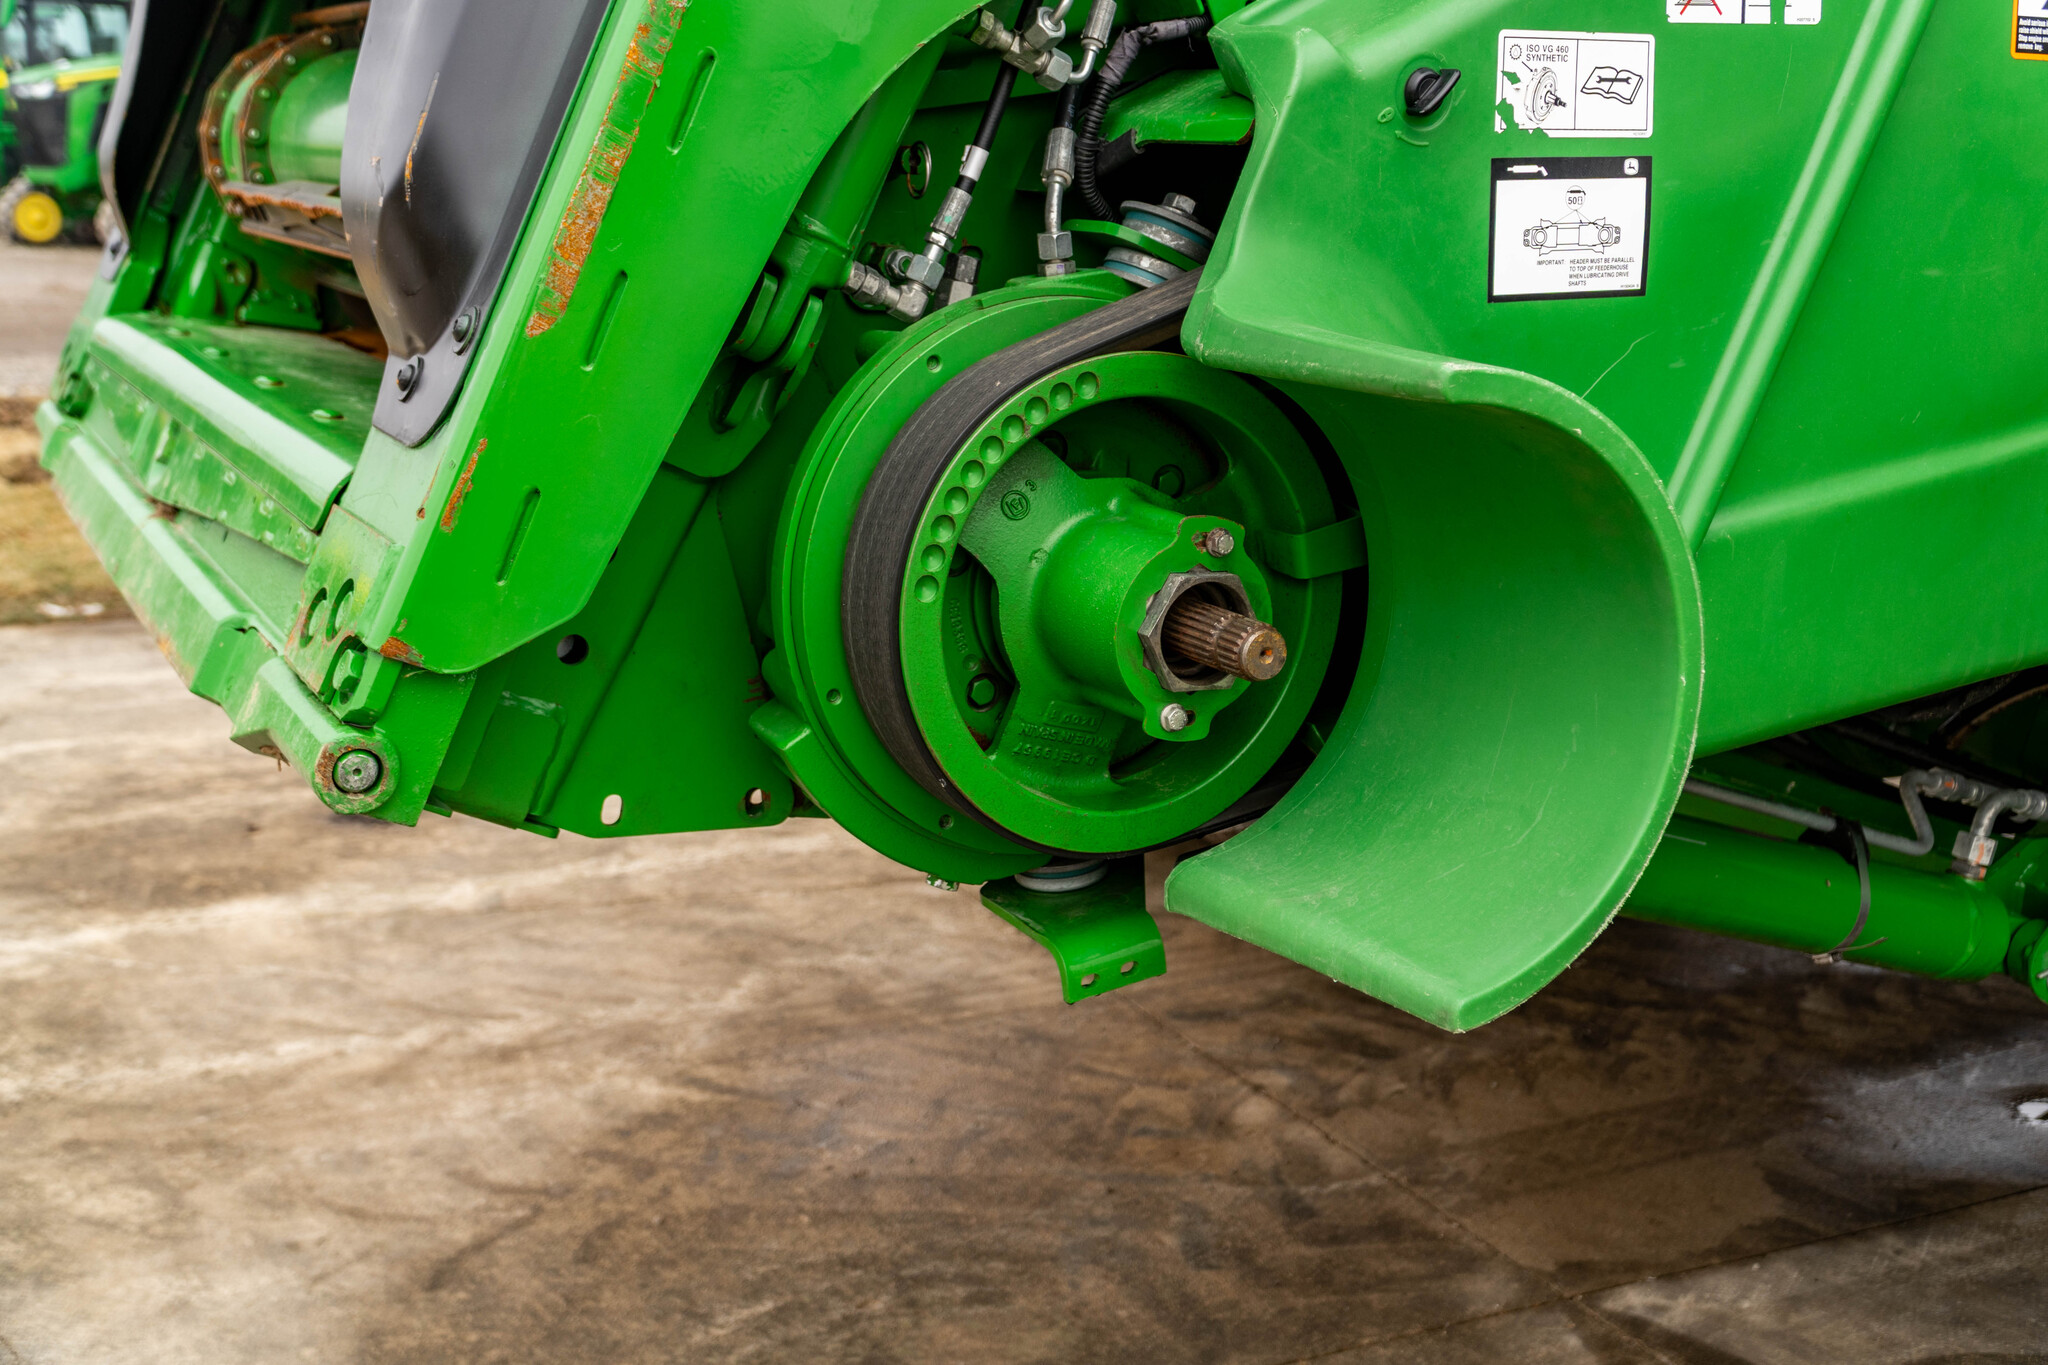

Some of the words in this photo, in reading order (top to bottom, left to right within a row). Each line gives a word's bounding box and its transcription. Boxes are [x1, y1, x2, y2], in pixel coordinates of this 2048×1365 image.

[2018, 34, 2027, 42] Stop
[1526, 44, 1540, 52] ISO
[1542, 45, 1553, 53] VG
[1556, 45, 1569, 53] 460
[1526, 53, 1569, 62] SYNTHETIC
[1568, 196, 1577, 205] 50
